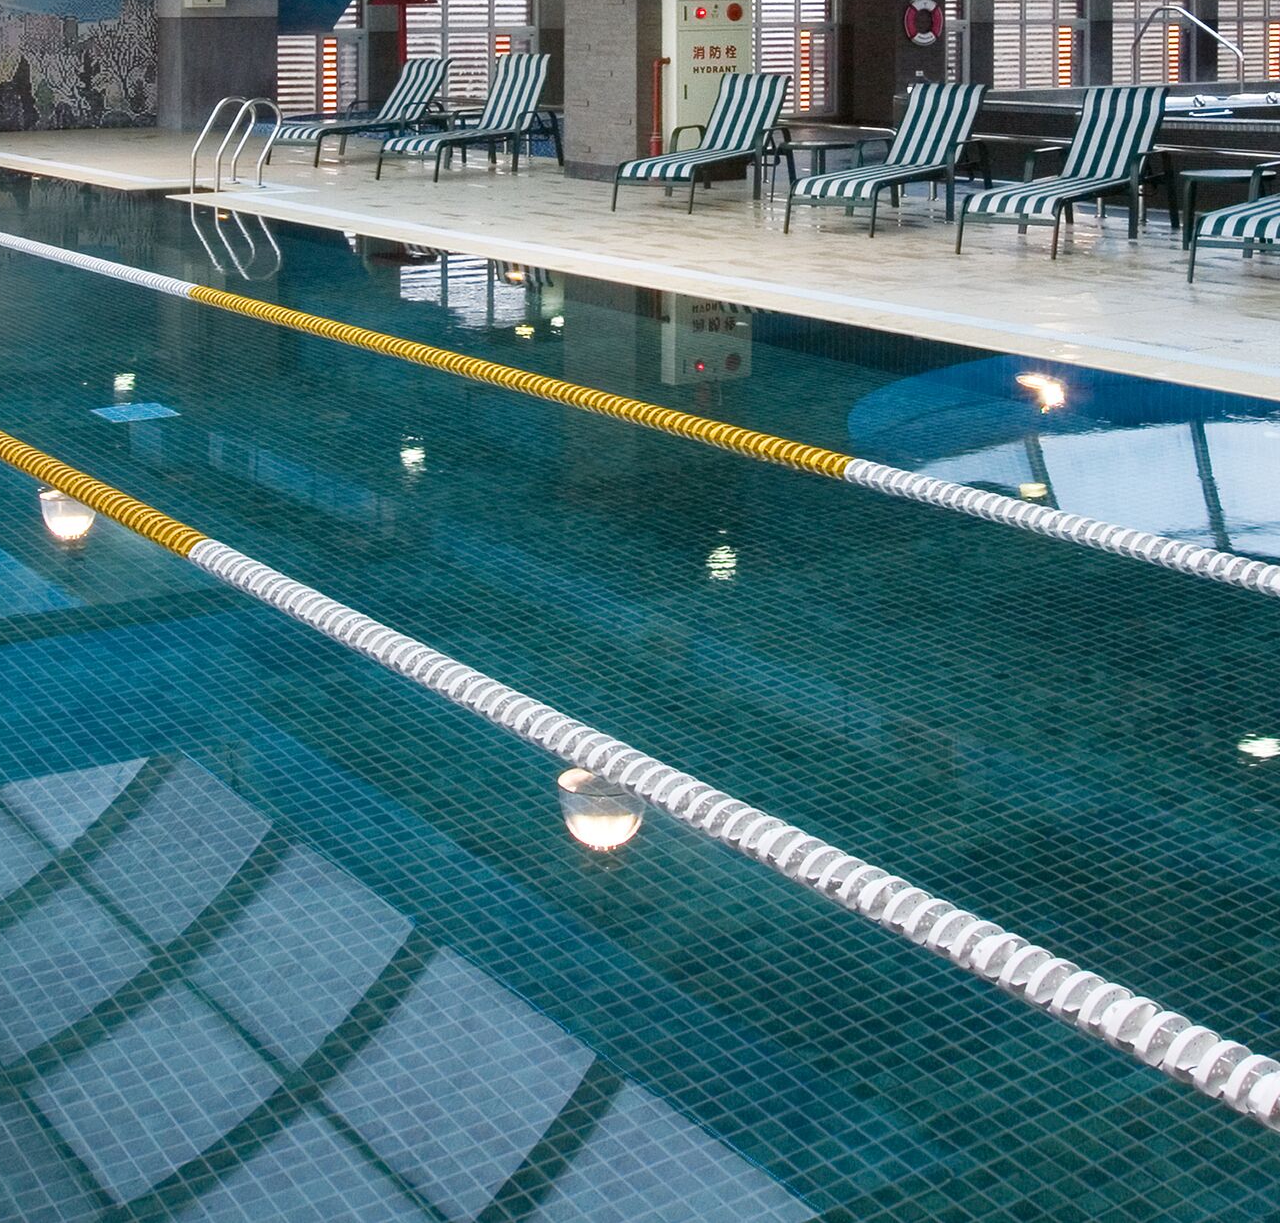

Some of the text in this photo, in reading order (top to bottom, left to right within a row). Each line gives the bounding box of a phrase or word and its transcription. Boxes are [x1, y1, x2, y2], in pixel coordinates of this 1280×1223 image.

[693, 45, 736, 59] 消防栓
[693, 65, 736, 73] HYDRANT
